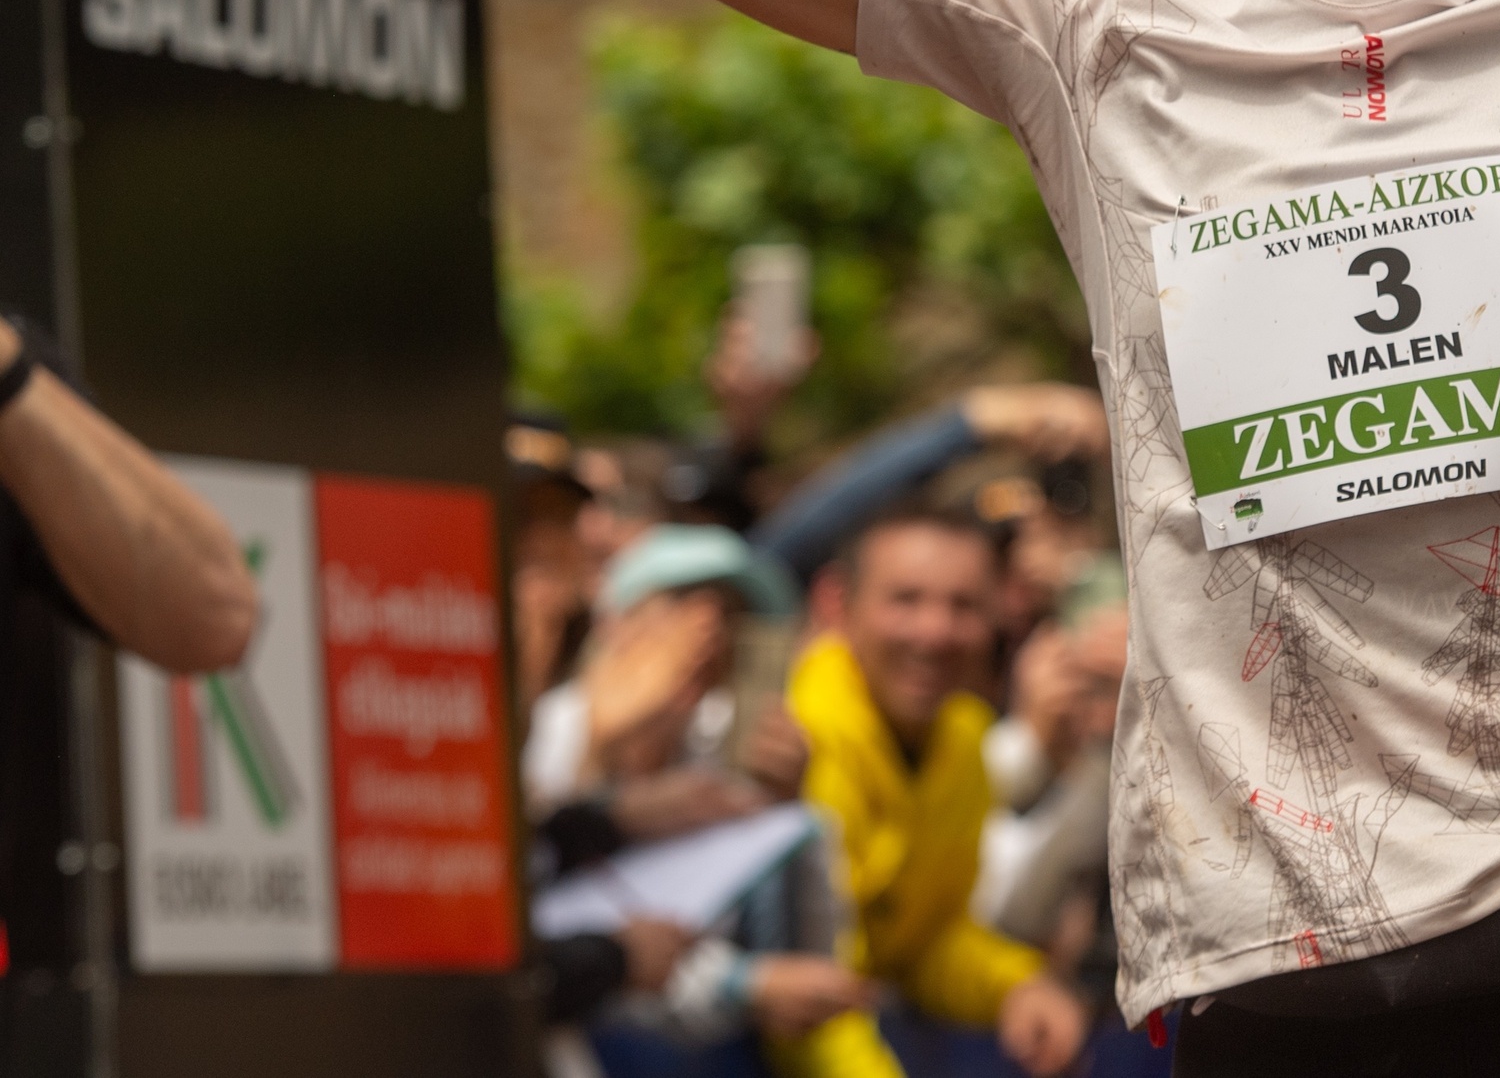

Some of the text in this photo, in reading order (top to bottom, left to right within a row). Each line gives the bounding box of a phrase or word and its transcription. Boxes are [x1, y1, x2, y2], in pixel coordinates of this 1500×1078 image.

[1263, 206, 1475, 260] XXV MENDI MARATOIA
[1347, 247, 1422, 335] 3
[1327, 331, 1464, 381] MALEN
[1336, 458, 1487, 503] SALOMON
